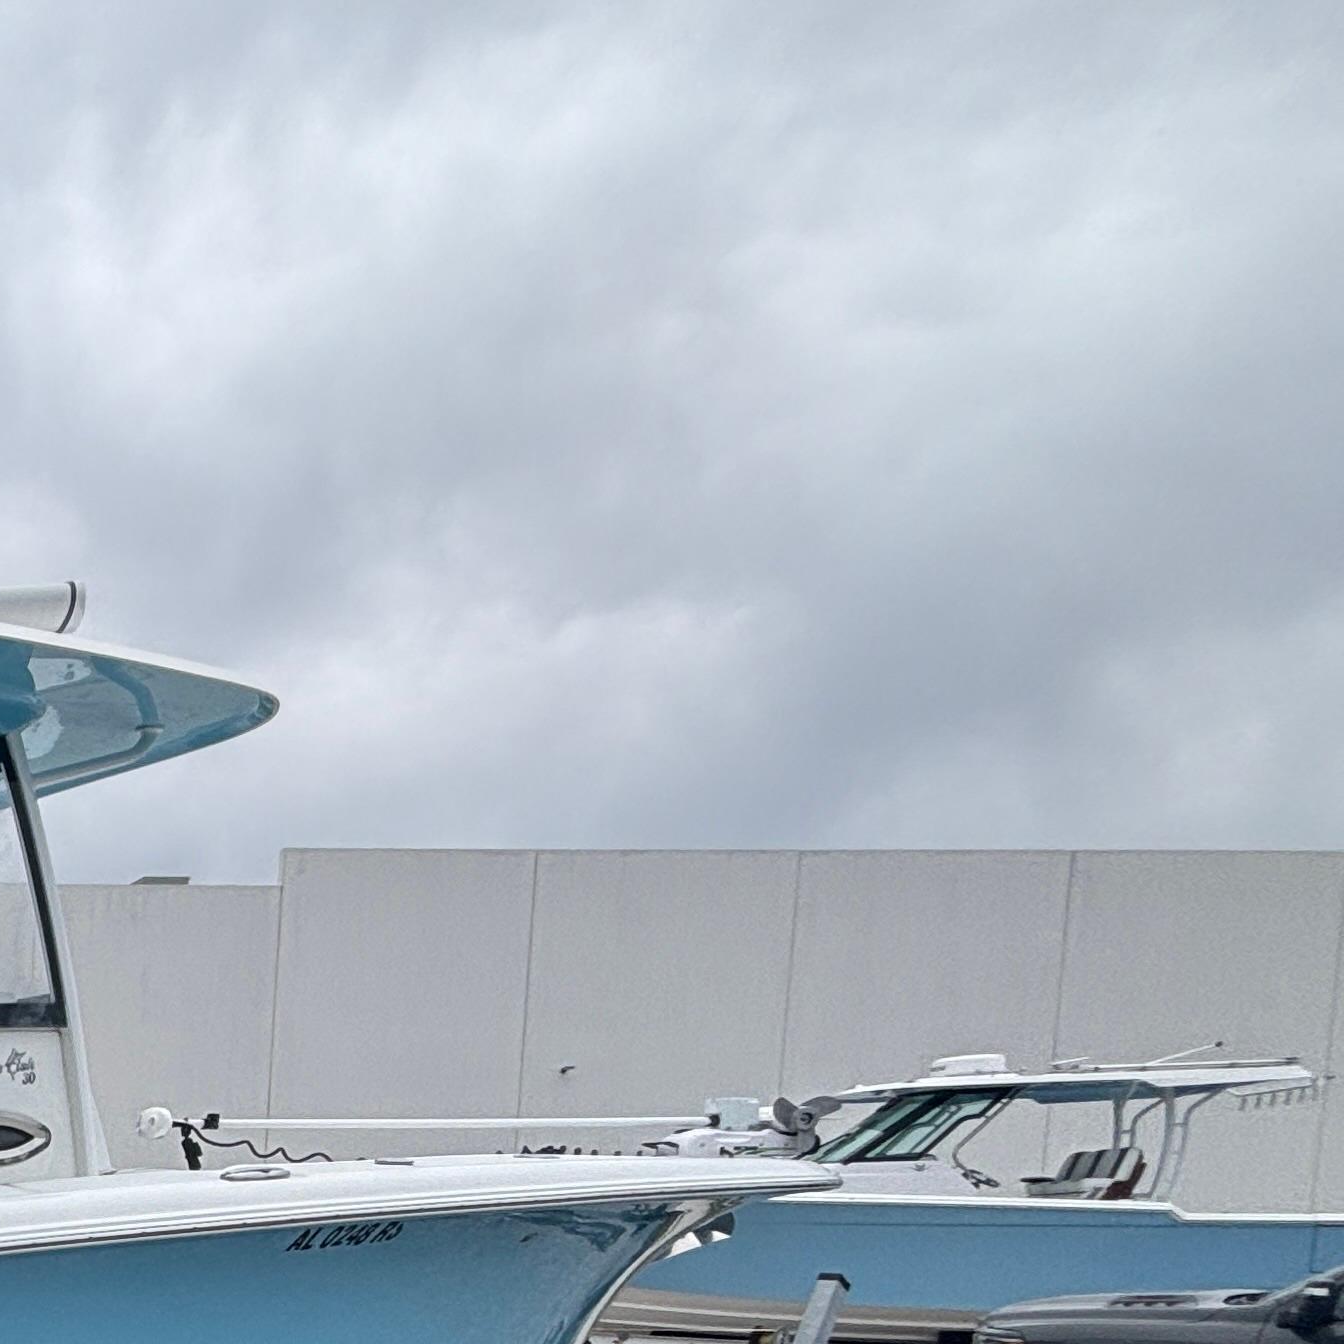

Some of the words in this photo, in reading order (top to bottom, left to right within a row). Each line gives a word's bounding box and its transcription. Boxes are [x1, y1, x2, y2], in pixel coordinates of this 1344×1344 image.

[21, 1071, 37, 1086] 30
[285, 1226, 324, 1252] AL
[319, 1222, 381, 1250] 0248
